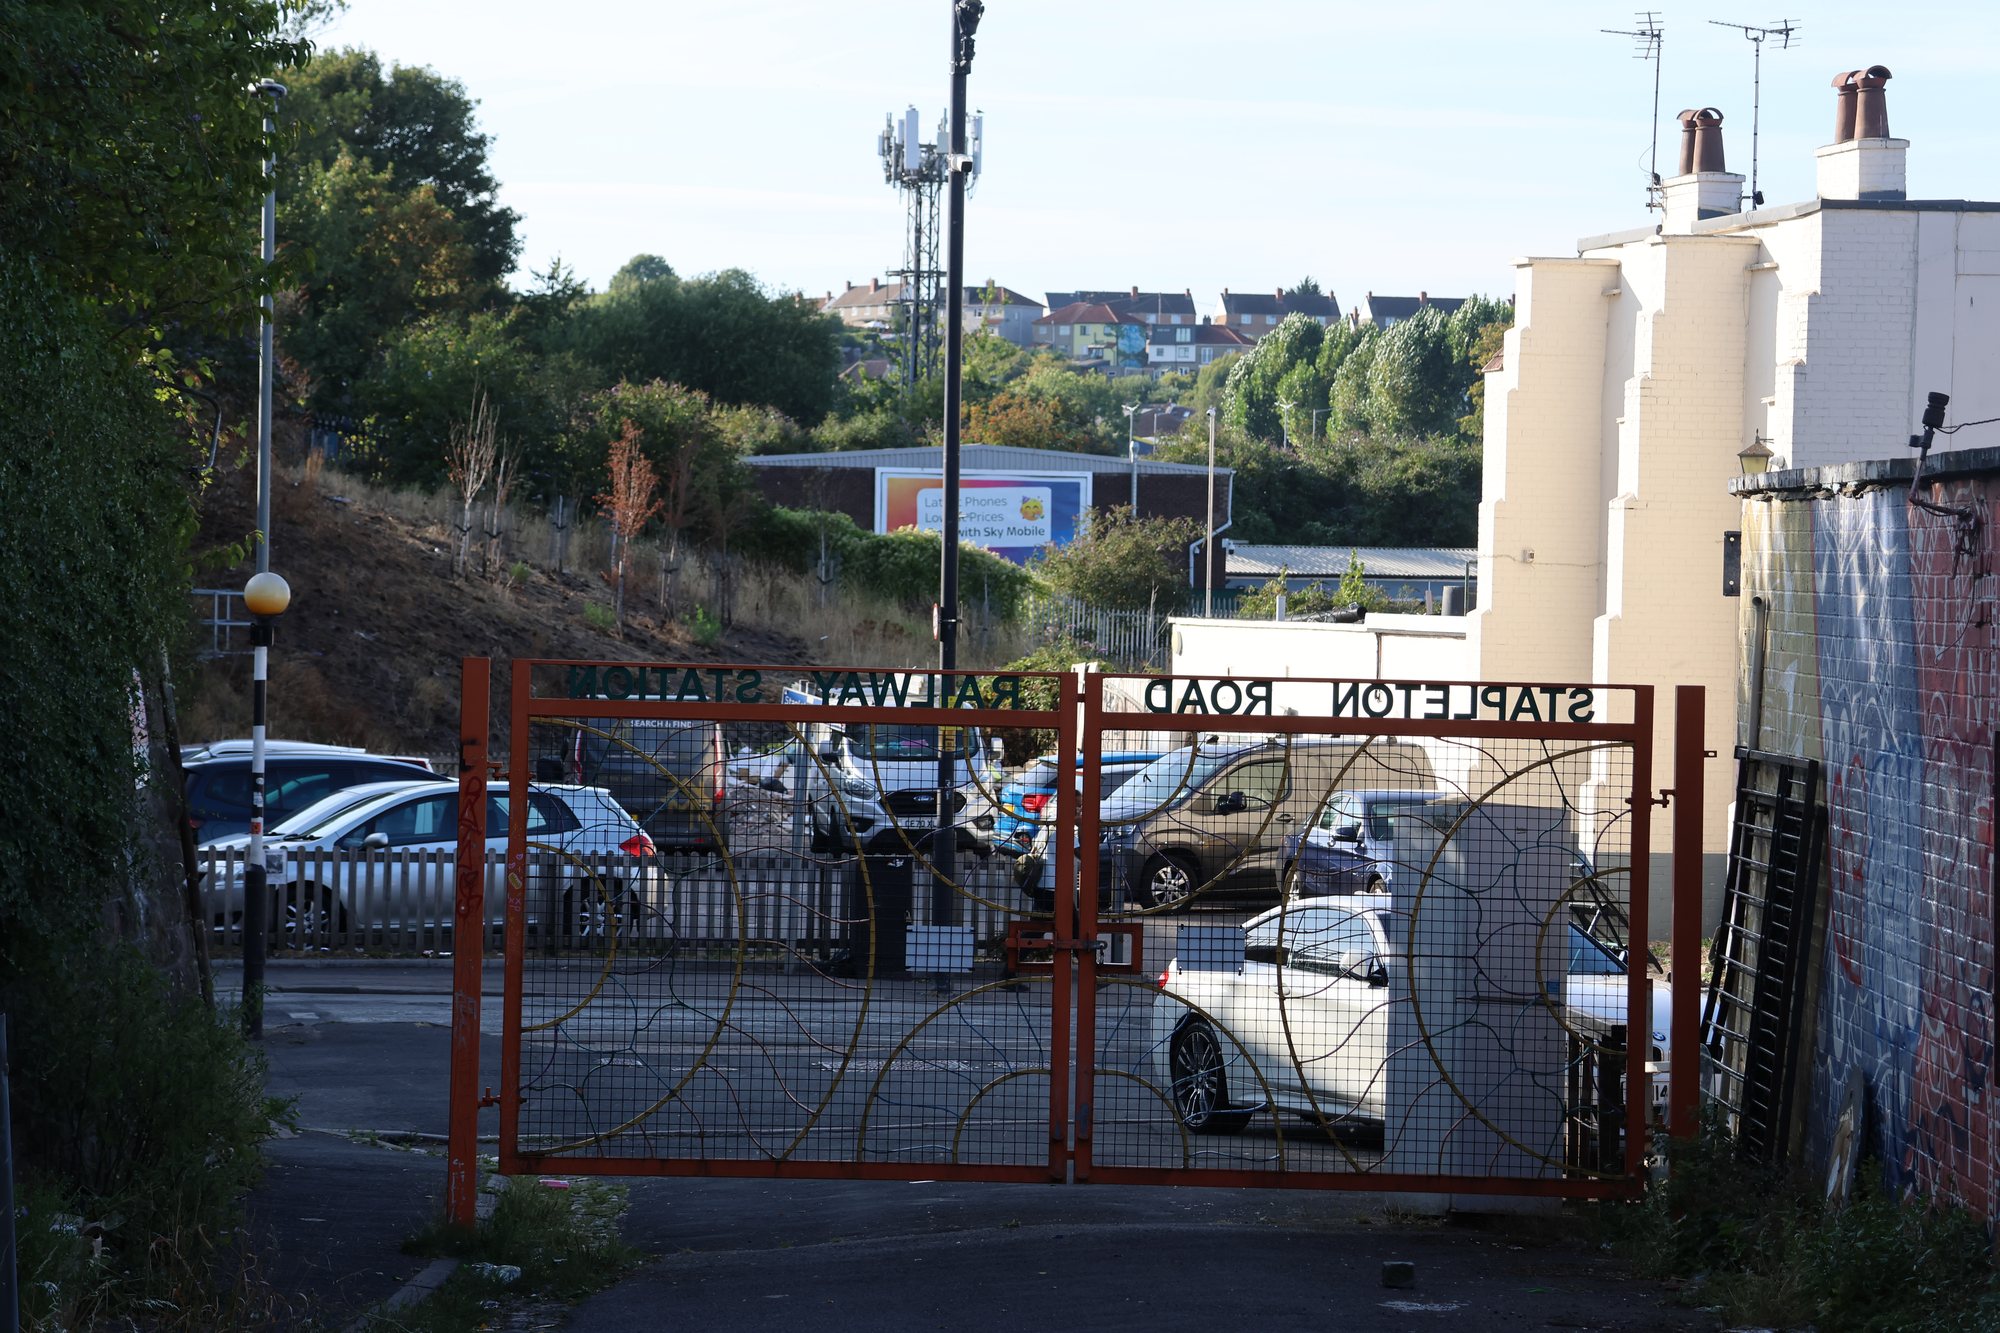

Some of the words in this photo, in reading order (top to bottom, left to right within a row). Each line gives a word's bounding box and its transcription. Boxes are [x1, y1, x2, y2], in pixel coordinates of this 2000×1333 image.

[925, 497, 962, 507] Lat
[965, 497, 1008, 507] Phones
[925, 513, 967, 523] Lowt
[969, 512, 1004, 522] Prices
[958, 527, 981, 537] with
[984, 527, 1003, 539] Sky
[1006, 526, 1045, 537] Mobile
[631, 719, 664, 727] SEARCH
[672, 720, 693, 728] FIND
